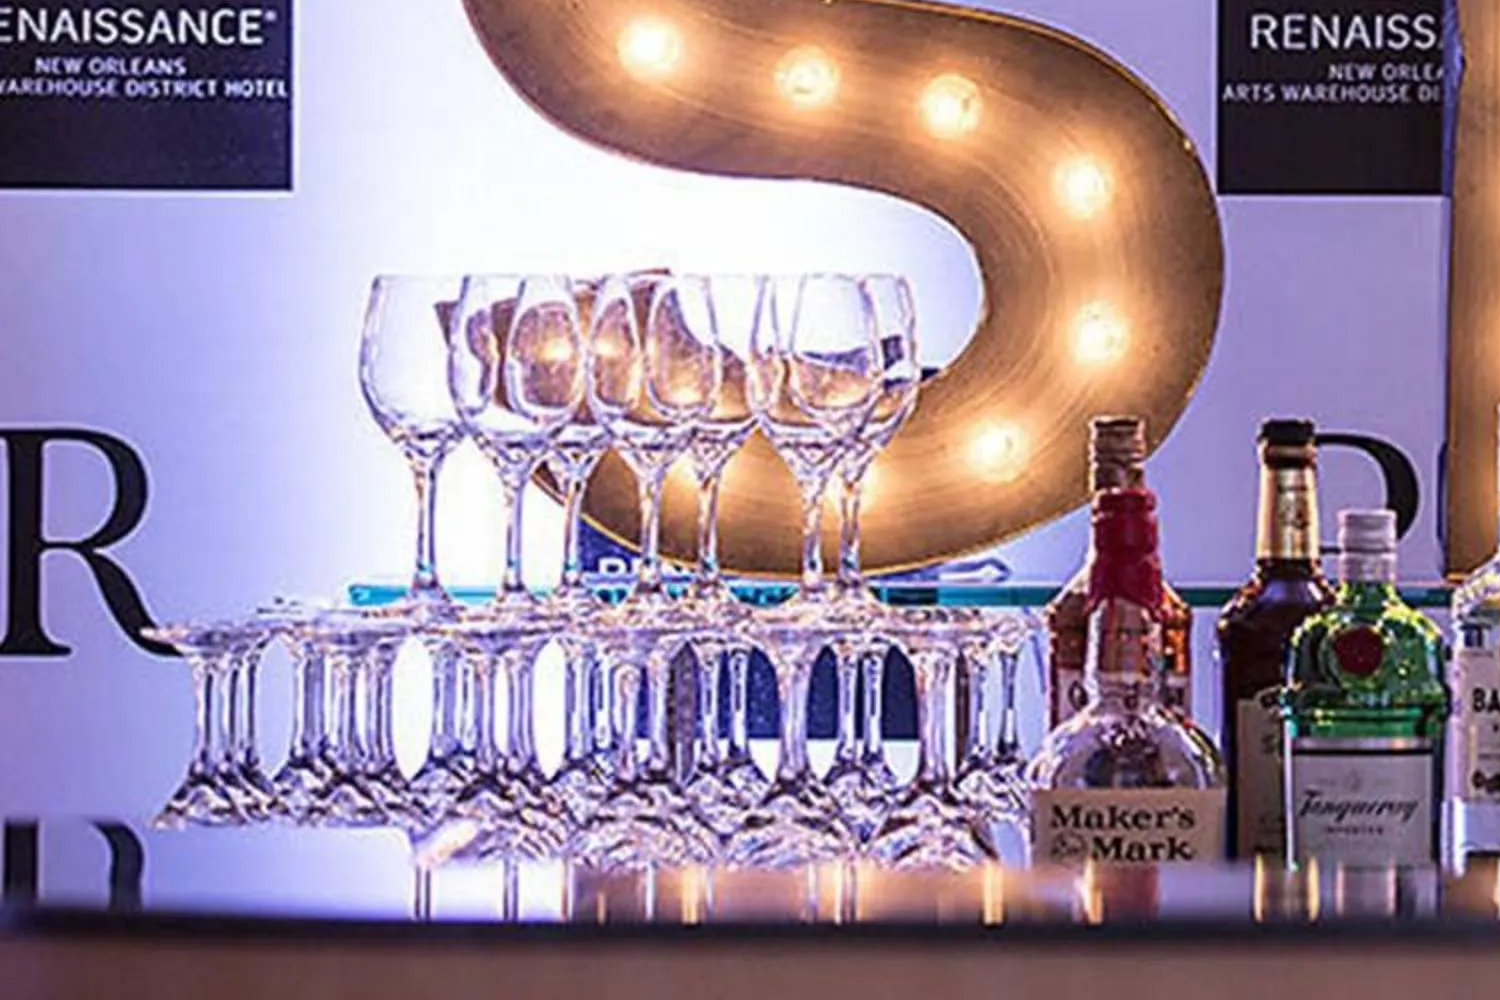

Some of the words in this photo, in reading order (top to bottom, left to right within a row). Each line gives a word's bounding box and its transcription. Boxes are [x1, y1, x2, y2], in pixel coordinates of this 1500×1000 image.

[0, 7, 264, 45] ENAISSANCE
[1250, 14, 1443, 50] RENAISS
[35, 56, 83, 75] NEW
[88, 56, 187, 76] ORLEANS
[1328, 63, 1377, 81] NEW
[1381, 63, 1443, 81] ORLE
[125, 79, 217, 98] DISTRICT
[224, 80, 287, 98] HOTEL
[1222, 83, 1276, 102] ARTS
[1280, 83, 1410, 102] WAREHOUSE
[0, 428, 184, 656] R
[1050, 804, 1196, 831] Maker's
[1092, 836, 1195, 862] Mark
